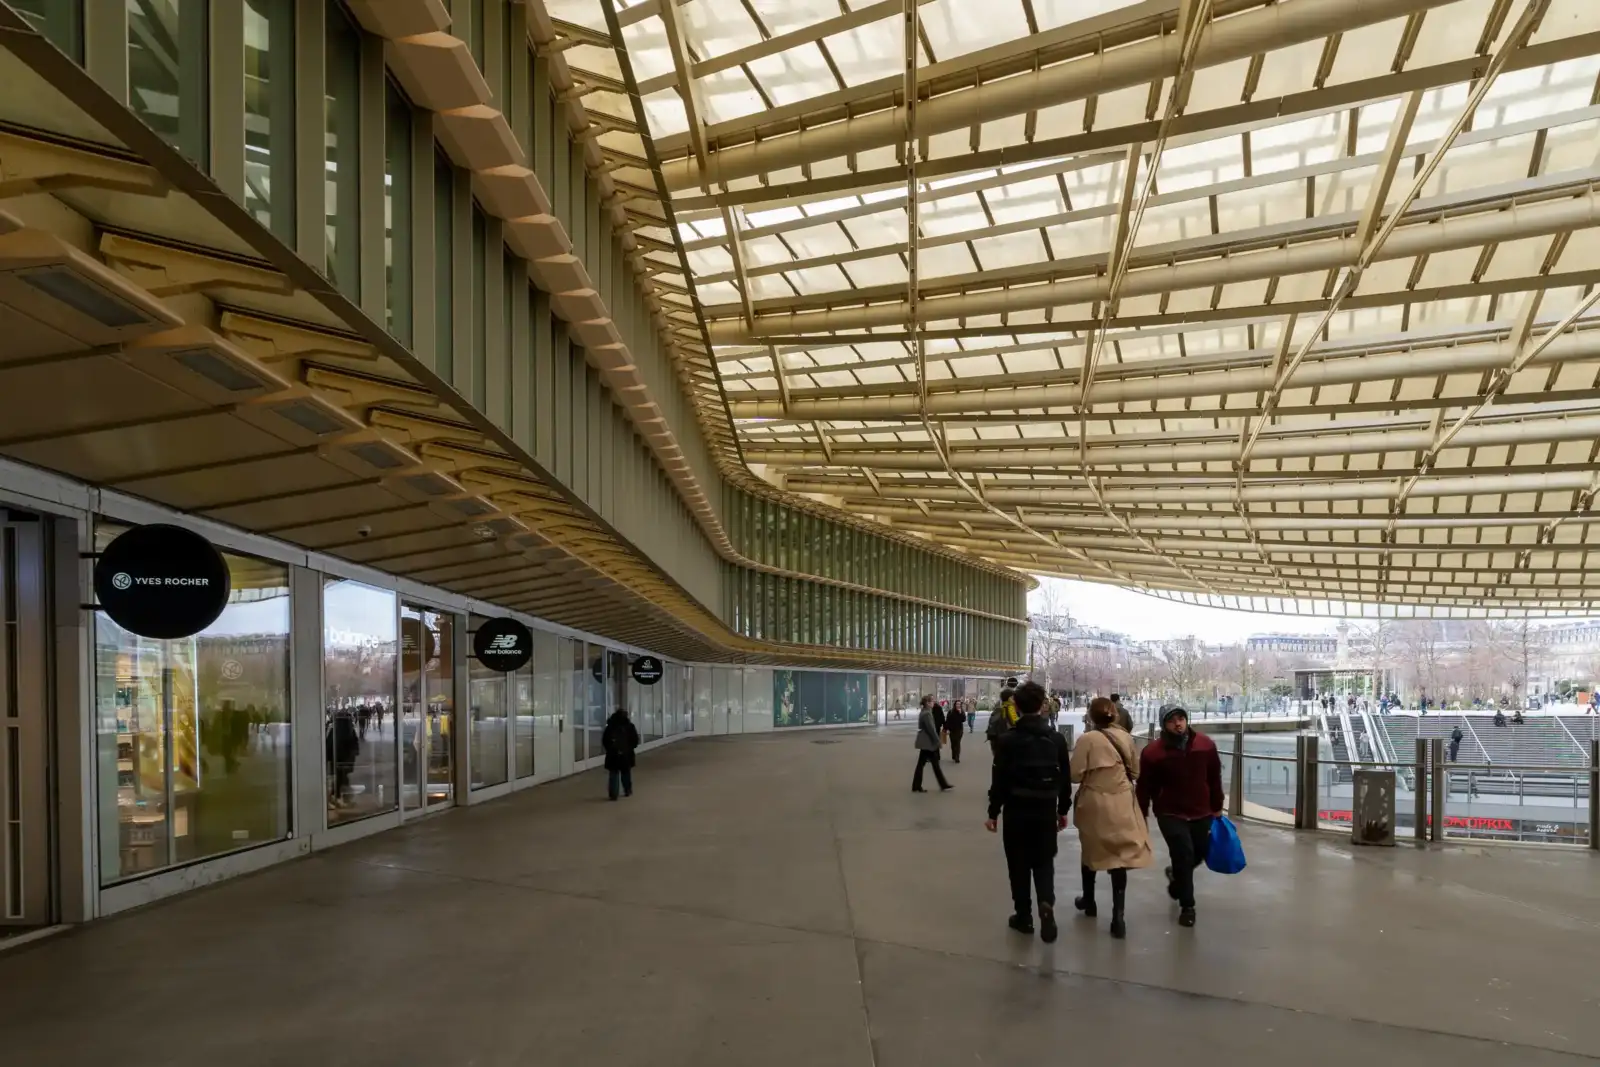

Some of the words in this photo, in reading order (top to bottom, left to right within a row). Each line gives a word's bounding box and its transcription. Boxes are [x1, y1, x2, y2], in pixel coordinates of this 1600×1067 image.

[135, 577, 162, 585] YVES
[165, 578, 209, 586] ROCHER
[1427, 814, 1513, 829] ONOPRIX
